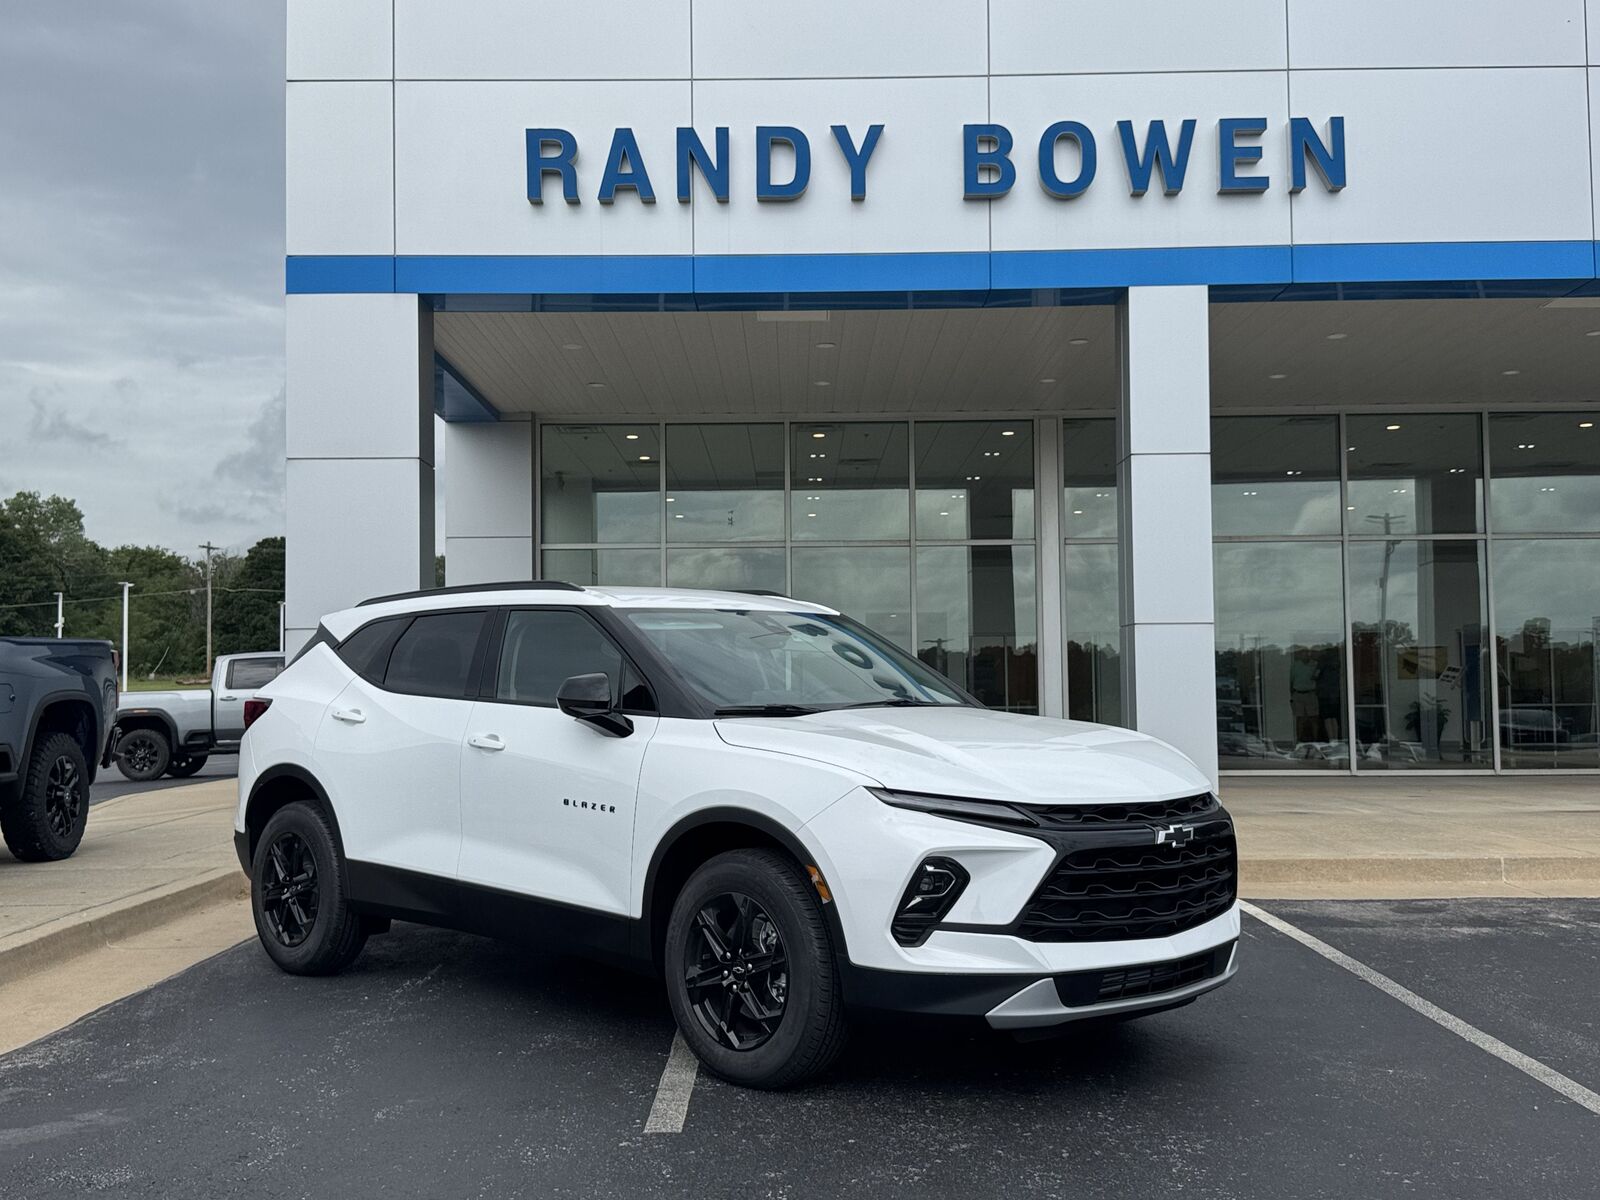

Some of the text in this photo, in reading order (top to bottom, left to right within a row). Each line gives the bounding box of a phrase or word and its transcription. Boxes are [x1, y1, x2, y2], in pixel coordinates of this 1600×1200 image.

[525, 116, 1347, 204] RANDY BOWEN
[563, 798, 616, 814] BLAZER
